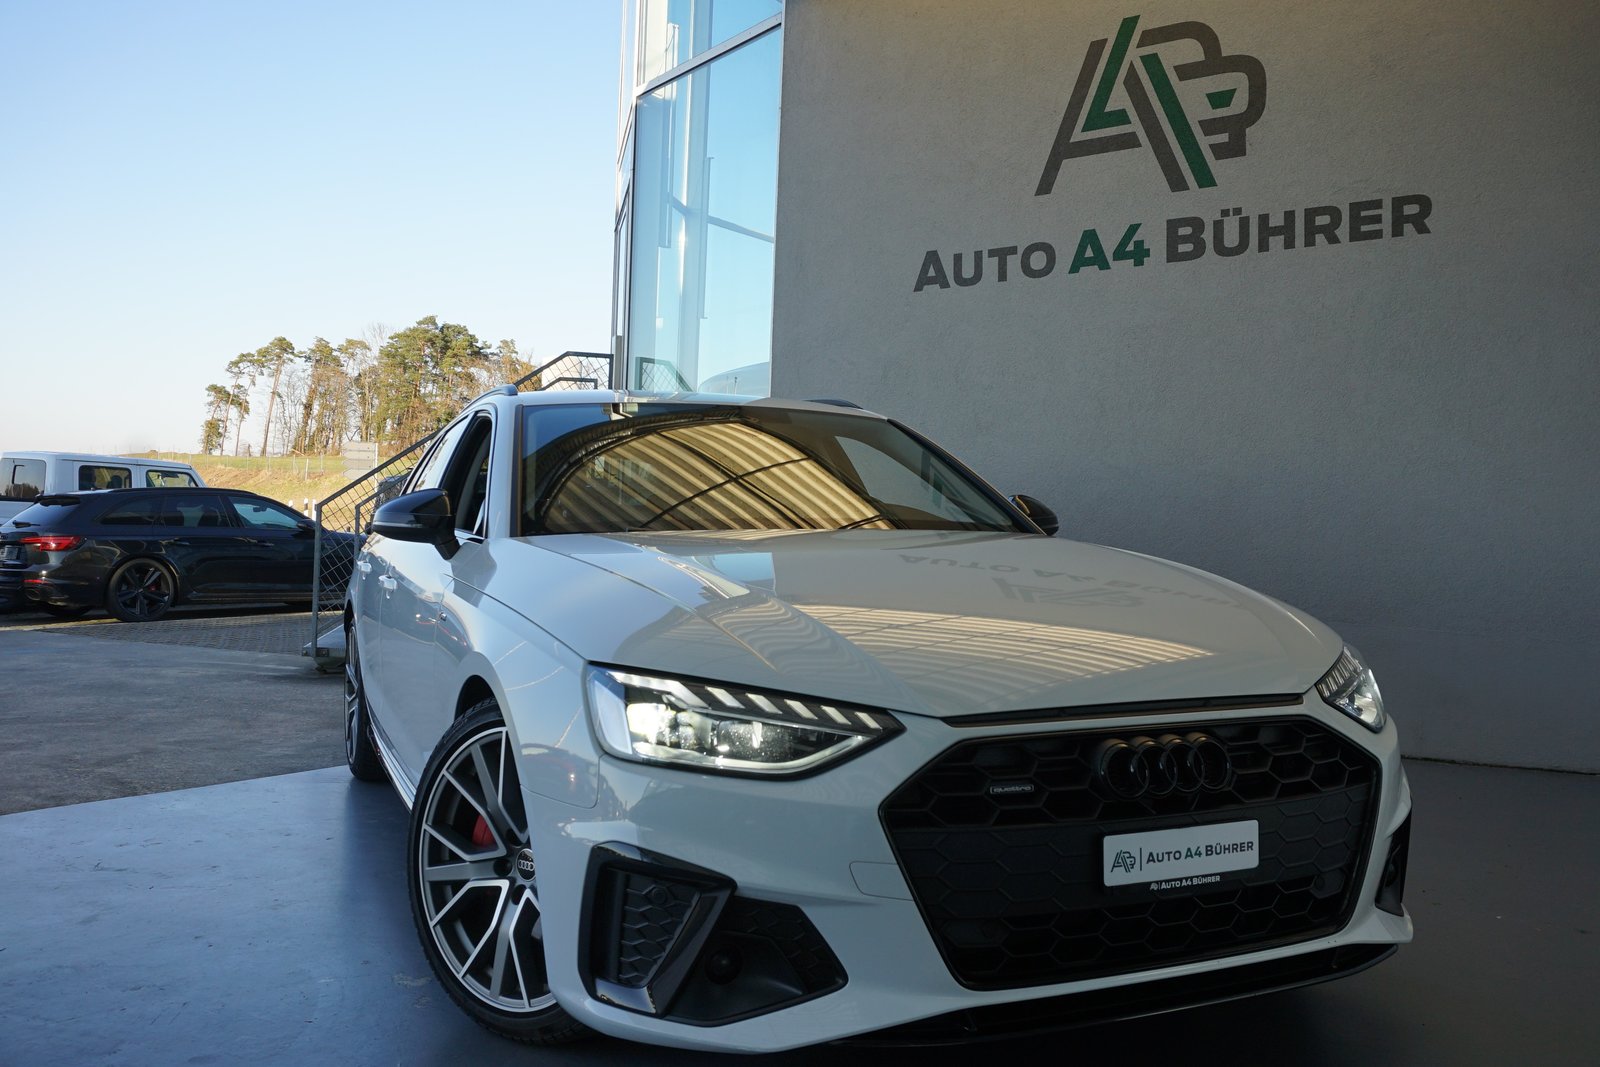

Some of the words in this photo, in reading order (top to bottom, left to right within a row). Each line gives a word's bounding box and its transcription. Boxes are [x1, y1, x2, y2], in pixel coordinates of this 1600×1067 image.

[912, 241, 1057, 293] AUTO
[1067, 222, 1151, 275] A4
[1165, 193, 1433, 264] BÜHRER
[993, 785, 1032, 794] quattro
[1146, 850, 1182, 865] AUTO
[1184, 846, 1203, 860] A4
[1205, 841, 1254, 857] BÜHRER
[1160, 880, 1181, 890] AUTO
[1181, 878, 1192, 887] A4
[1192, 875, 1221, 885] BÜHRER
